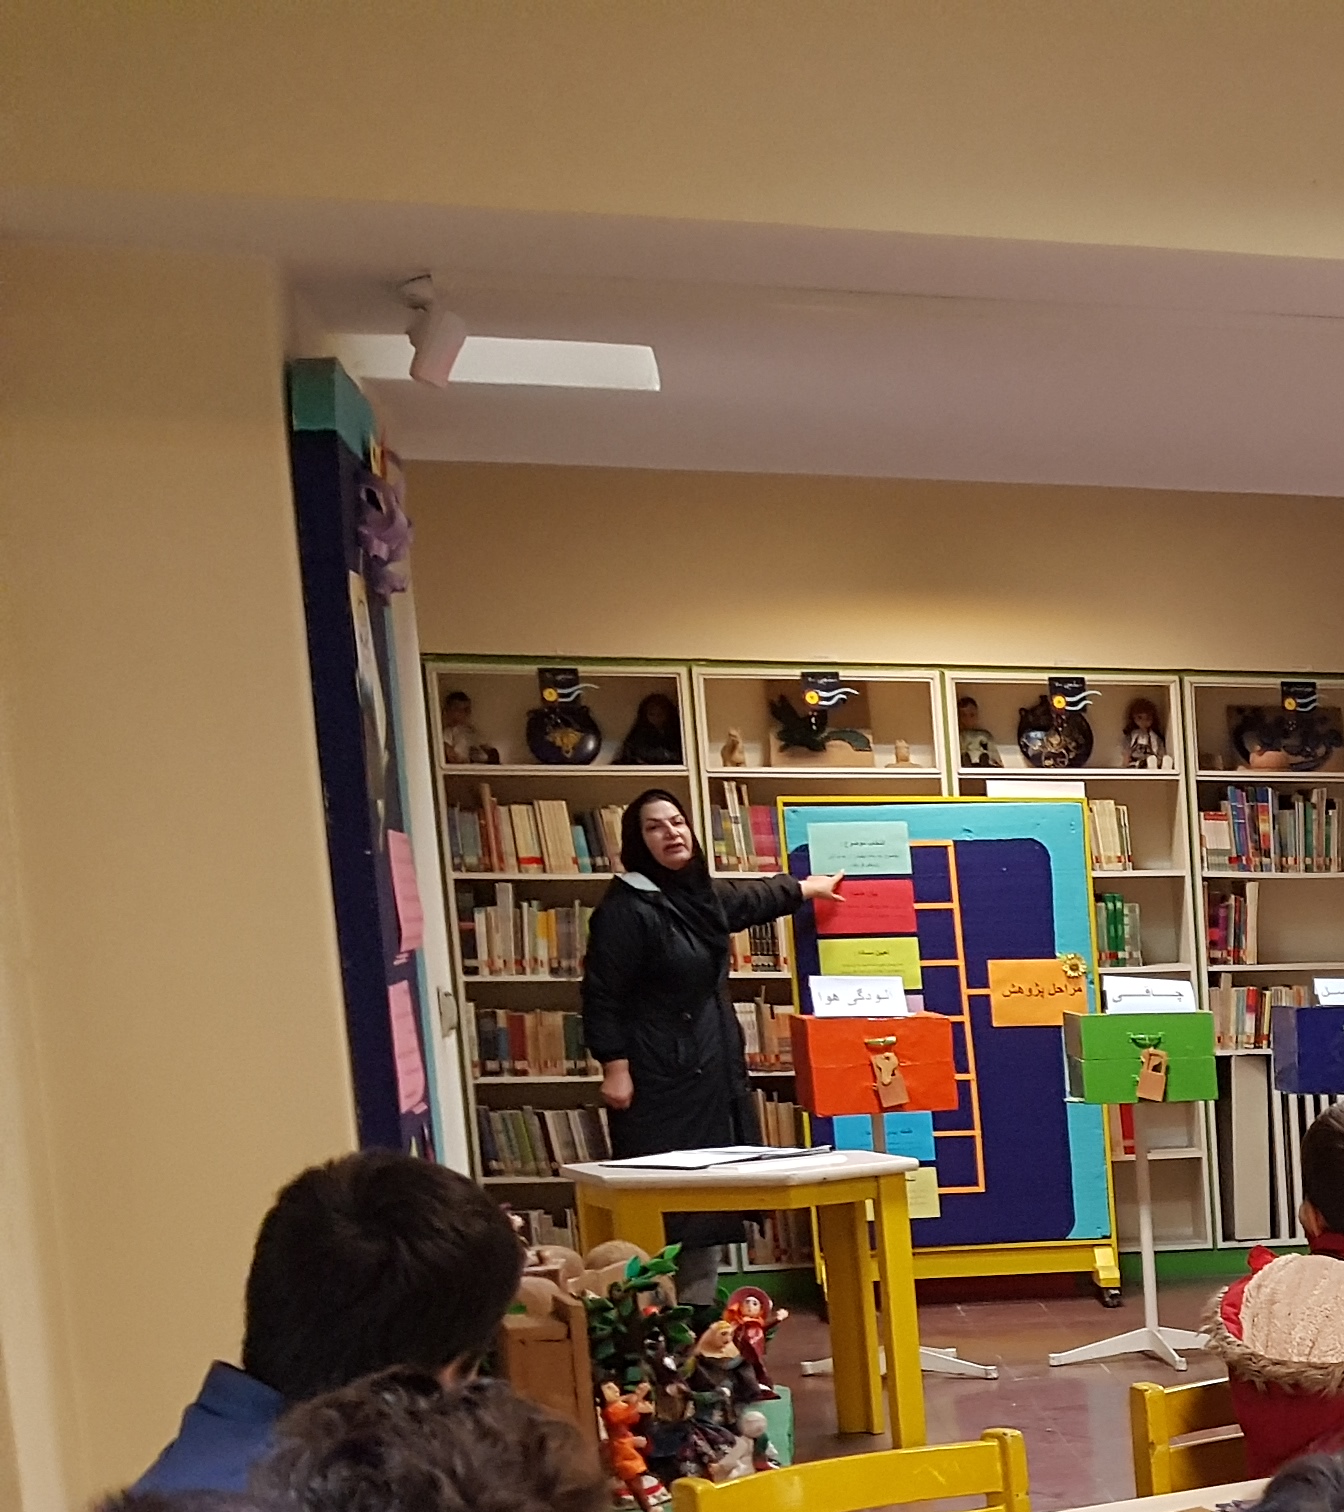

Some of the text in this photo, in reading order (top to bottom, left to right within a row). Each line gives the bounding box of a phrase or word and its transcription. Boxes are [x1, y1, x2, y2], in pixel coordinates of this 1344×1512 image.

[1002, 982, 1082, 998] مراحل پژوهش
[818, 991, 839, 1006] هوا
